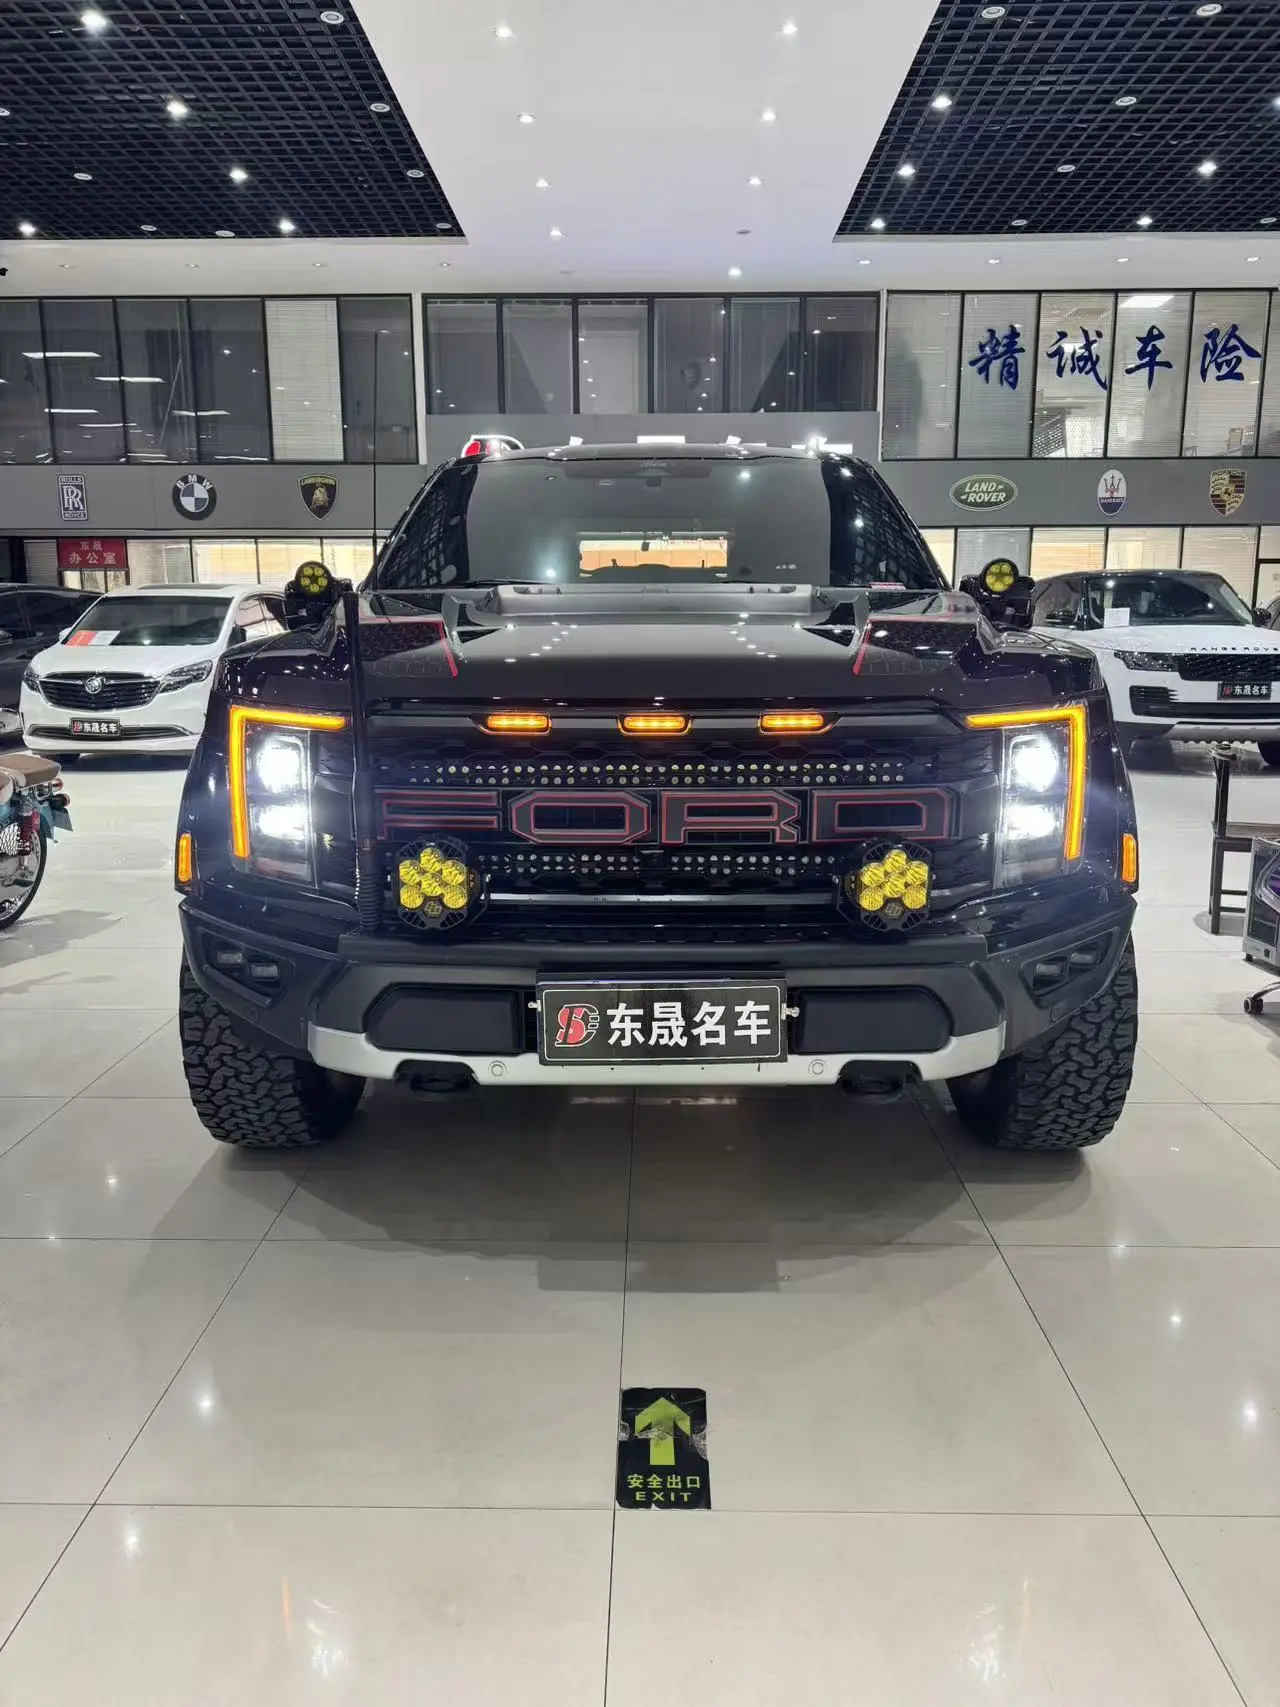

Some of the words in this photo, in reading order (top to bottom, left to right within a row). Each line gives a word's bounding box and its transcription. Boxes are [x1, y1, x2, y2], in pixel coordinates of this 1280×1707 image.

[968, 324, 1262, 392] 精诚车险
[176, 474, 213, 490] BMW
[69, 551, 117, 565] 办公室
[373, 787, 957, 844] FORD
[606, 1000, 772, 1048] 东晟名车
[627, 1474, 701, 1489] 安全出口
[635, 1491, 692, 1502] EXIT
